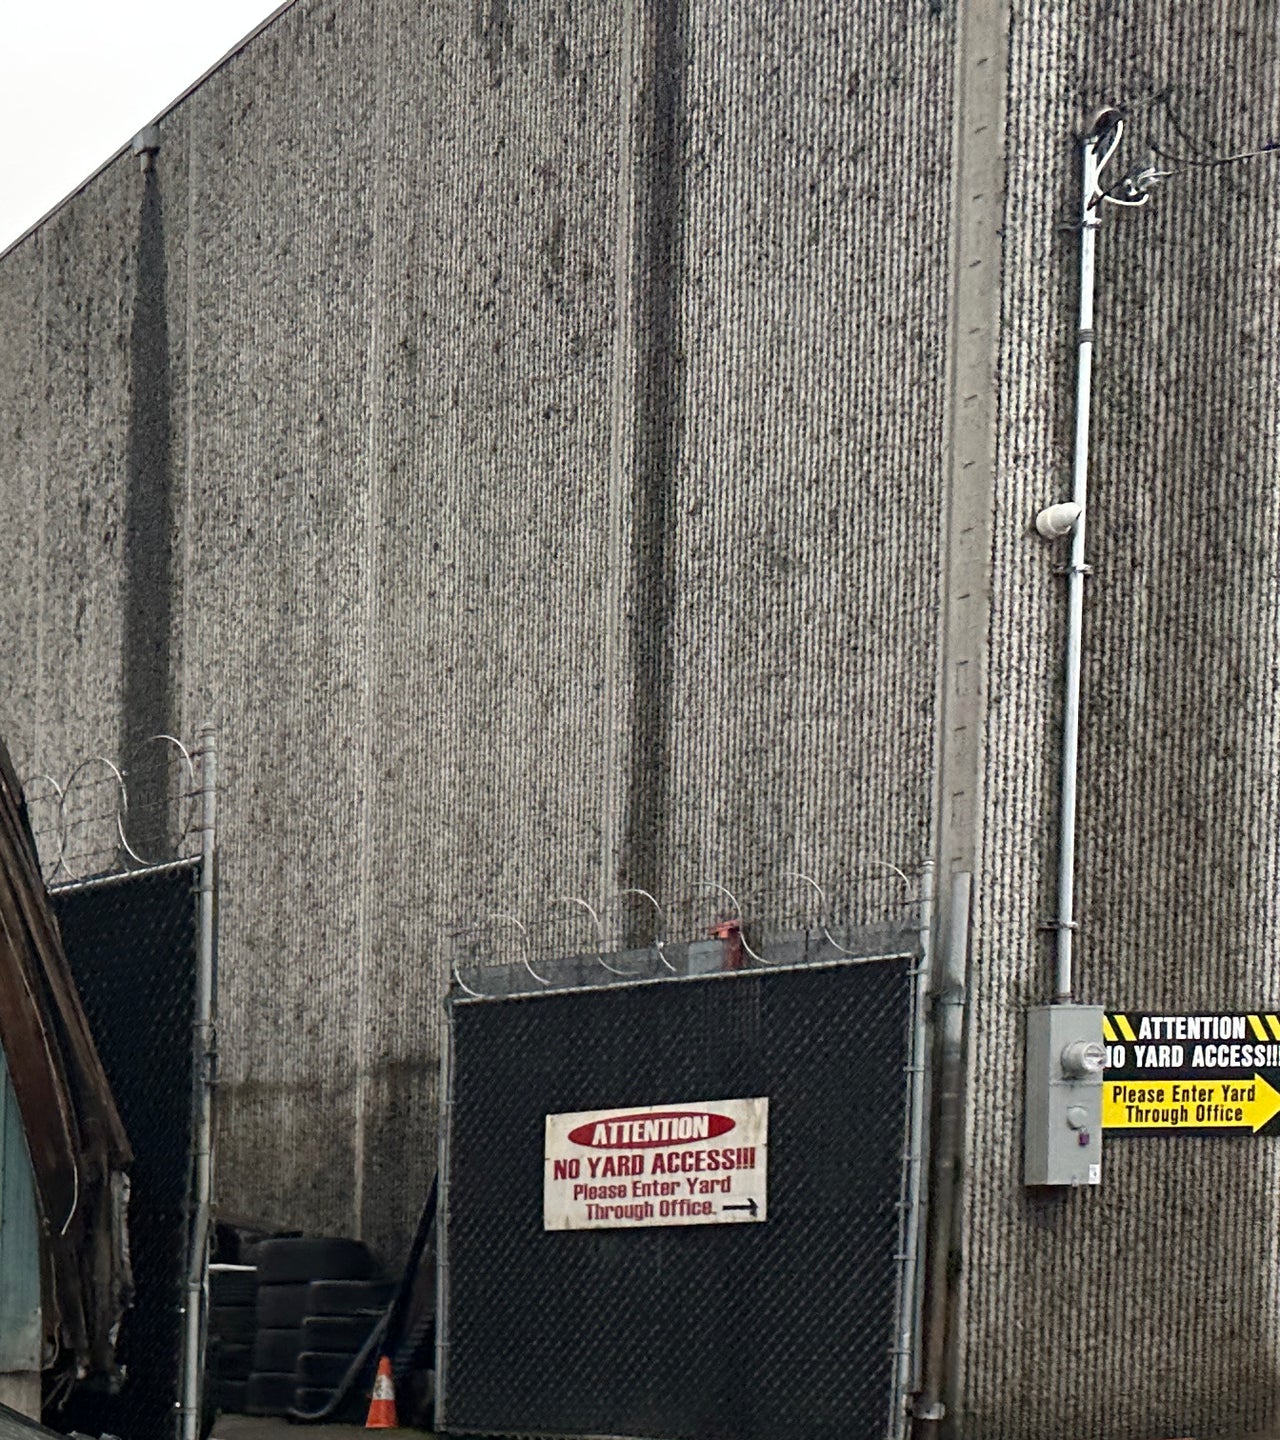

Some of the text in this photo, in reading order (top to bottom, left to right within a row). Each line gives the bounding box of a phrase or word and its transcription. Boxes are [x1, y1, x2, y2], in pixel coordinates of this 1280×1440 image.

[1138, 1016, 1246, 1040] ATTENTION
[1133, 1045, 1184, 1068] YARD
[1112, 1085, 1256, 1104] Please Enter Yard
[1125, 1104, 1244, 1125] Through Office
[591, 1115, 710, 1146] ATTENTION
[553, 1147, 756, 1181] NO YARD ACCESS!!!
[573, 1175, 732, 1201] Please Enter Yard
[585, 1202, 654, 1222] Through
